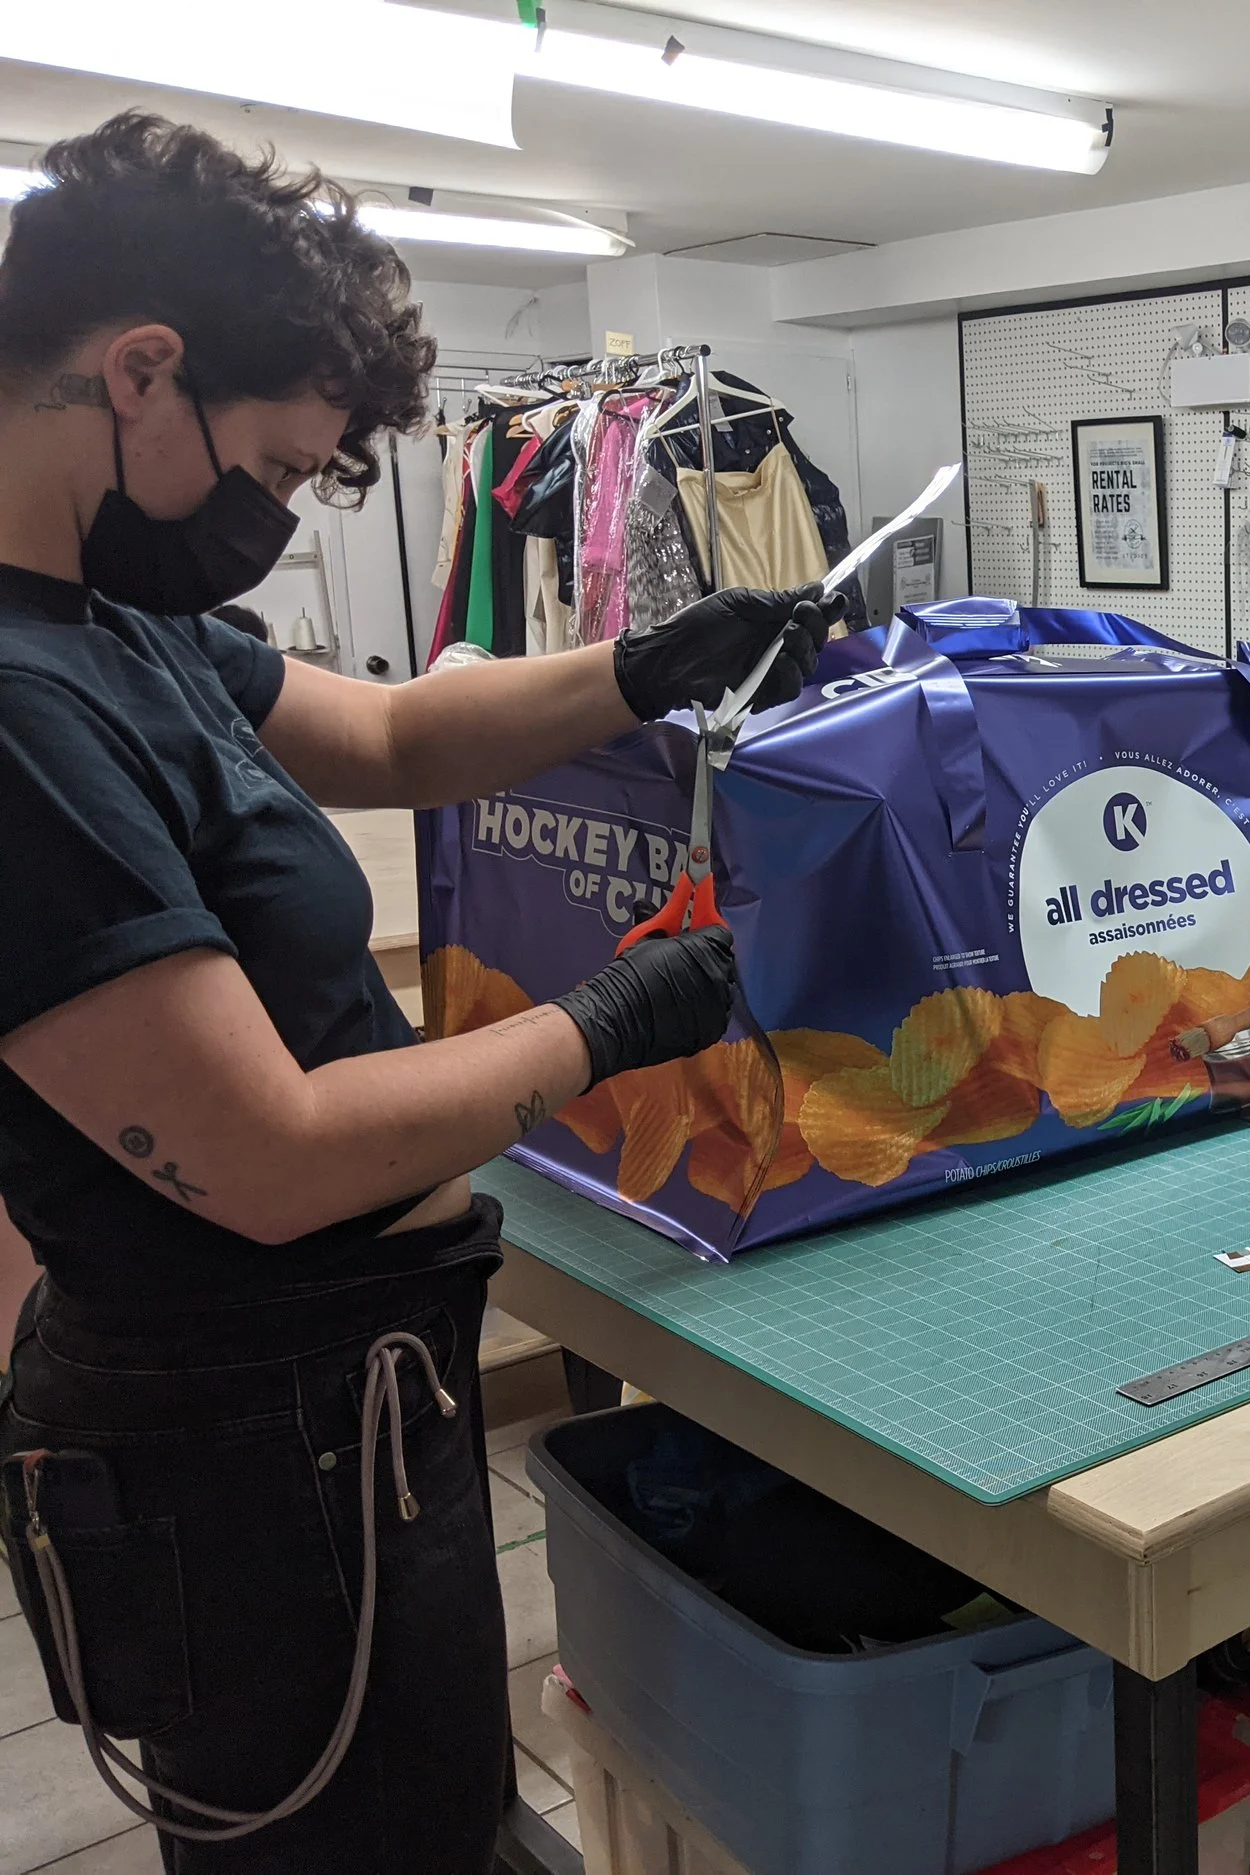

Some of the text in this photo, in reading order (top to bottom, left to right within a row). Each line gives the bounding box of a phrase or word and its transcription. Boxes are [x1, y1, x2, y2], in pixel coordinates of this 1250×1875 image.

[1092, 470, 1137, 490] RENTAL
[1093, 494, 1131, 513] RATES
[1072, 760, 1088, 772] IT!
[1115, 751, 1140, 759] VOUS
[1144, 754, 1174, 770] ALLEZ
[1043, 769, 1070, 793] LOVE
[1176, 766, 1220, 798] ADORER,
[1018, 794, 1042, 828] YOU'LL
[1225, 798, 1250, 825] C'EST
[478, 798, 639, 872] HOCKEY
[644, 832, 691, 886] BA
[1007, 832, 1021, 906] GUARANTEE
[569, 870, 600, 899] OF
[1045, 859, 1235, 926] all dressed
[1007, 914, 1015, 933] WE
[1089, 914, 1196, 945] assaisonnées
[945, 1166, 974, 1183] POTATO
